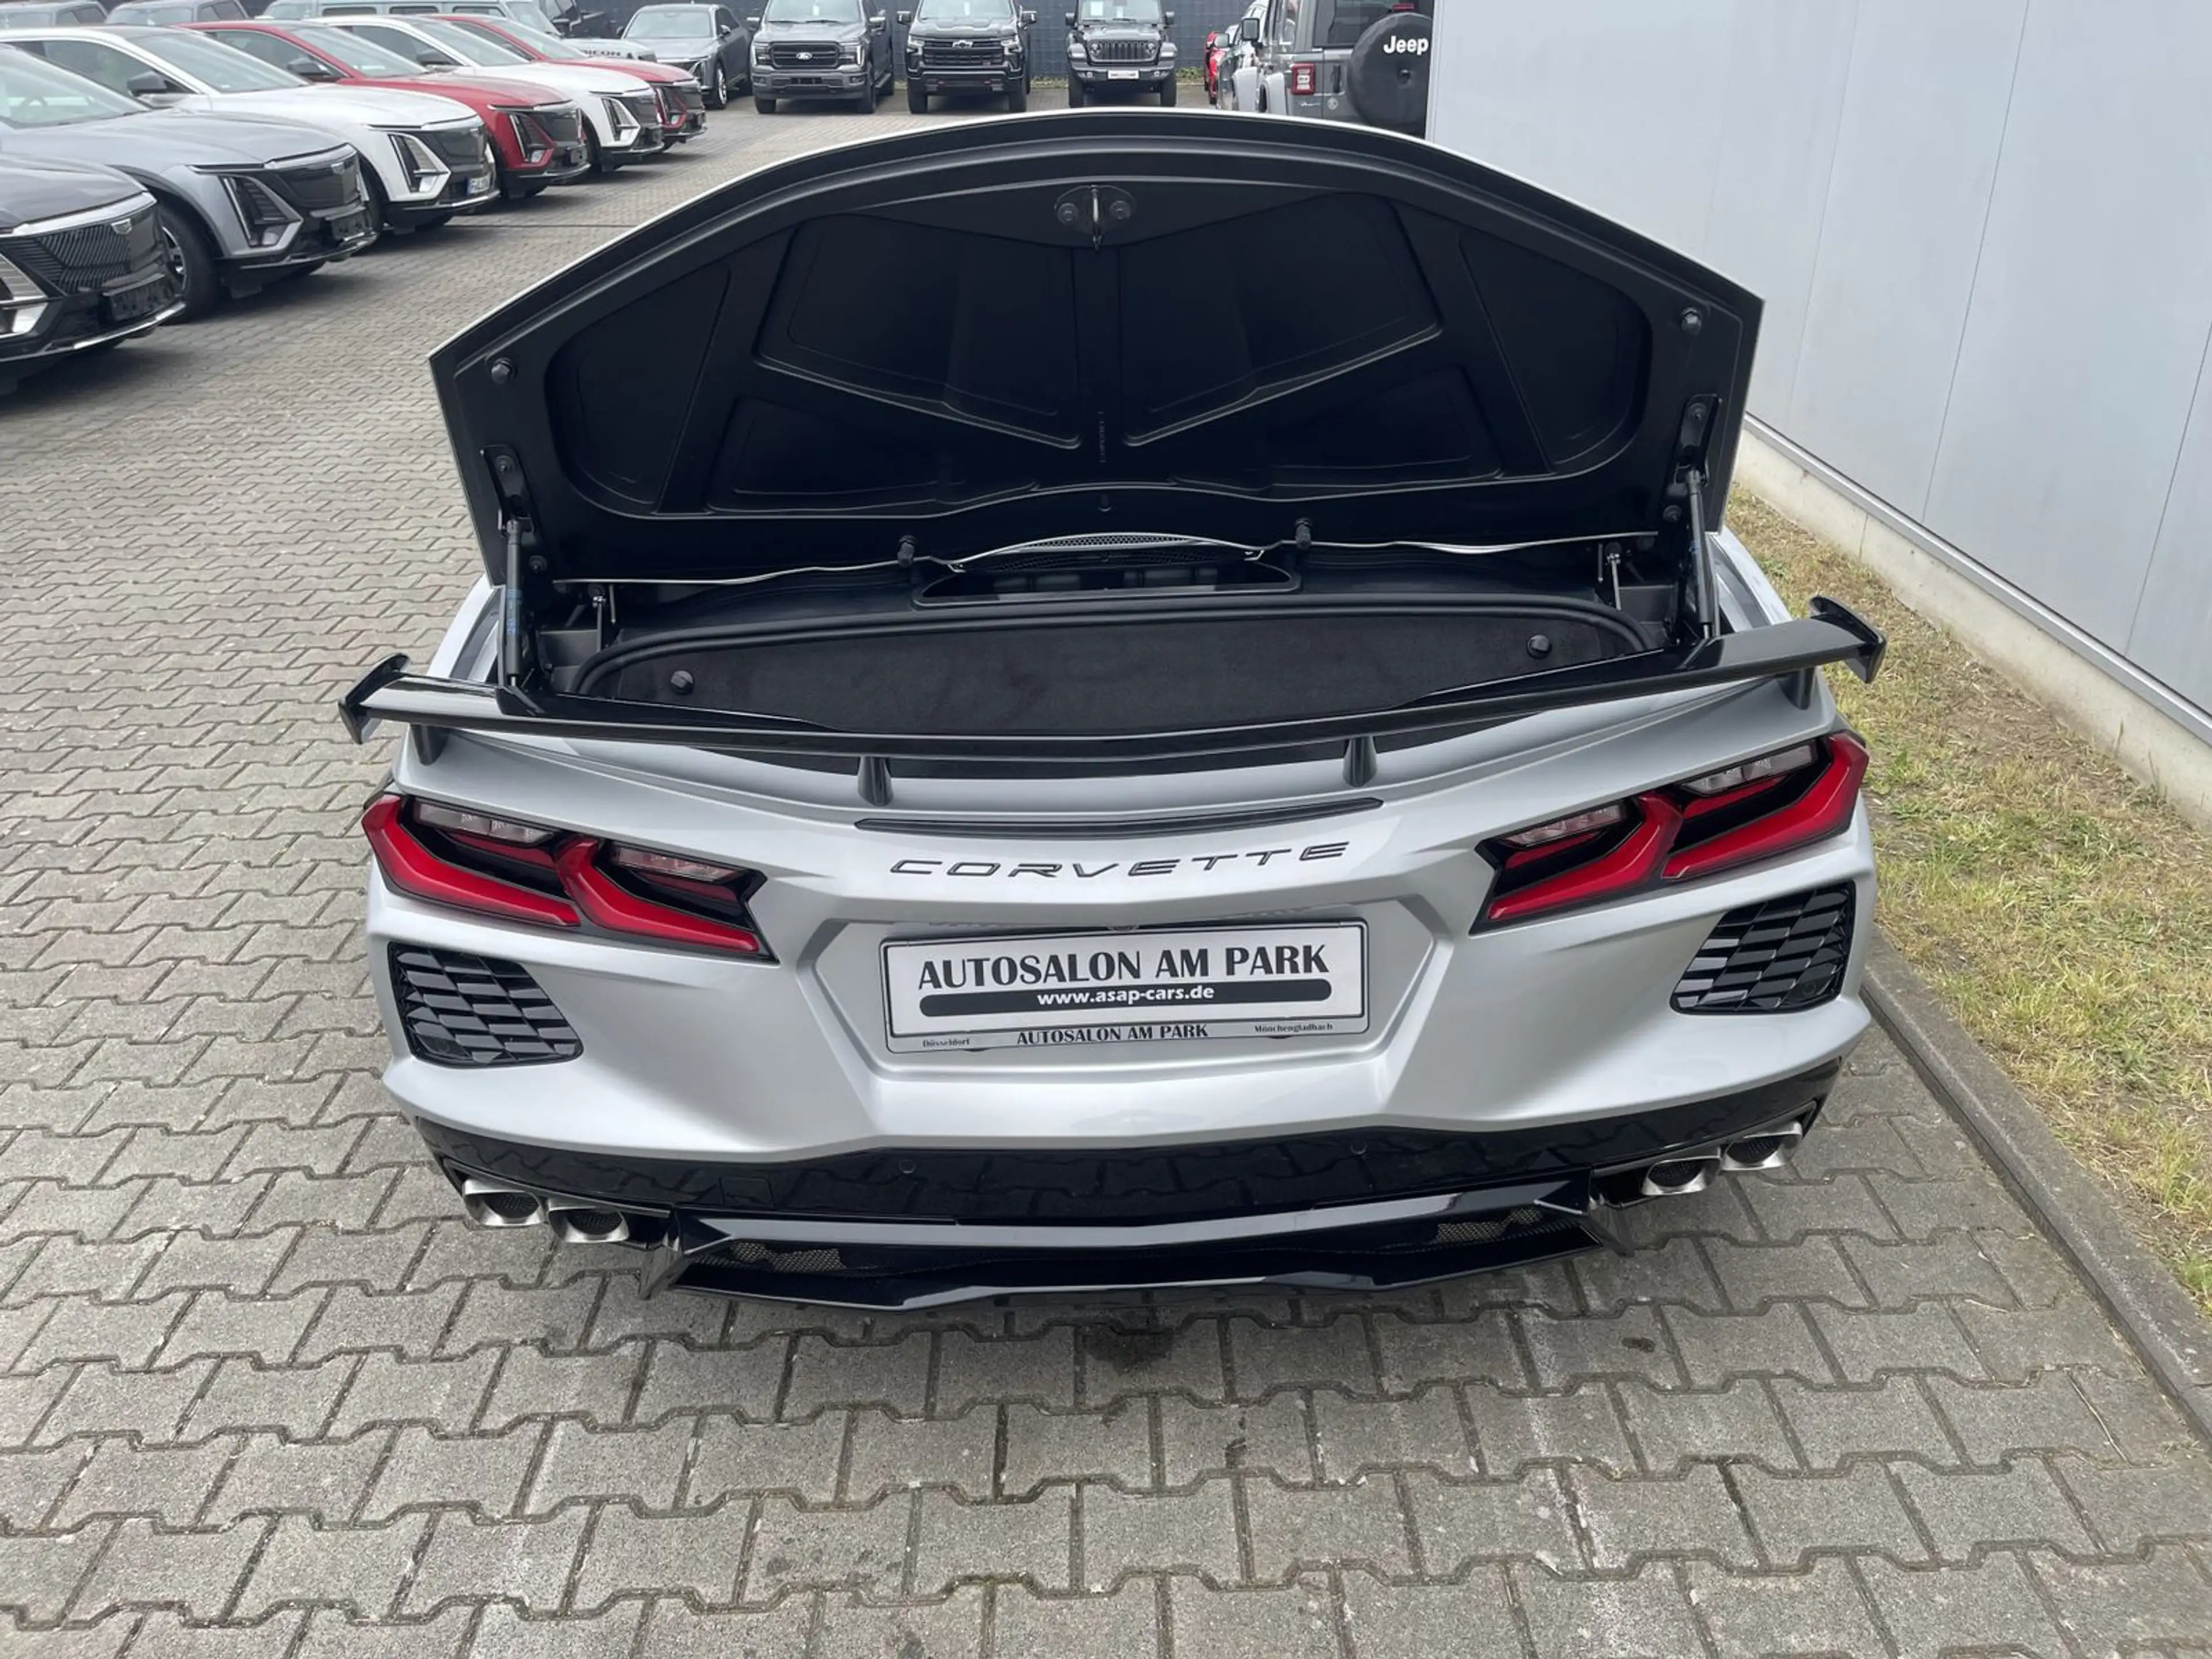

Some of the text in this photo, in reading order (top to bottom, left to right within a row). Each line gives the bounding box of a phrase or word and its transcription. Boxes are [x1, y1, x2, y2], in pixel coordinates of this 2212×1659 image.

[1383, 35, 1429, 55] Jeep
[890, 841, 1350, 877] CORVETTE
[918, 944, 1329, 990] AUTOSALON AM PARK
[1037, 986, 1214, 1005] www.asap-cars.de
[1017, 1024, 1208, 1044] AUTOSALON AM PARK
